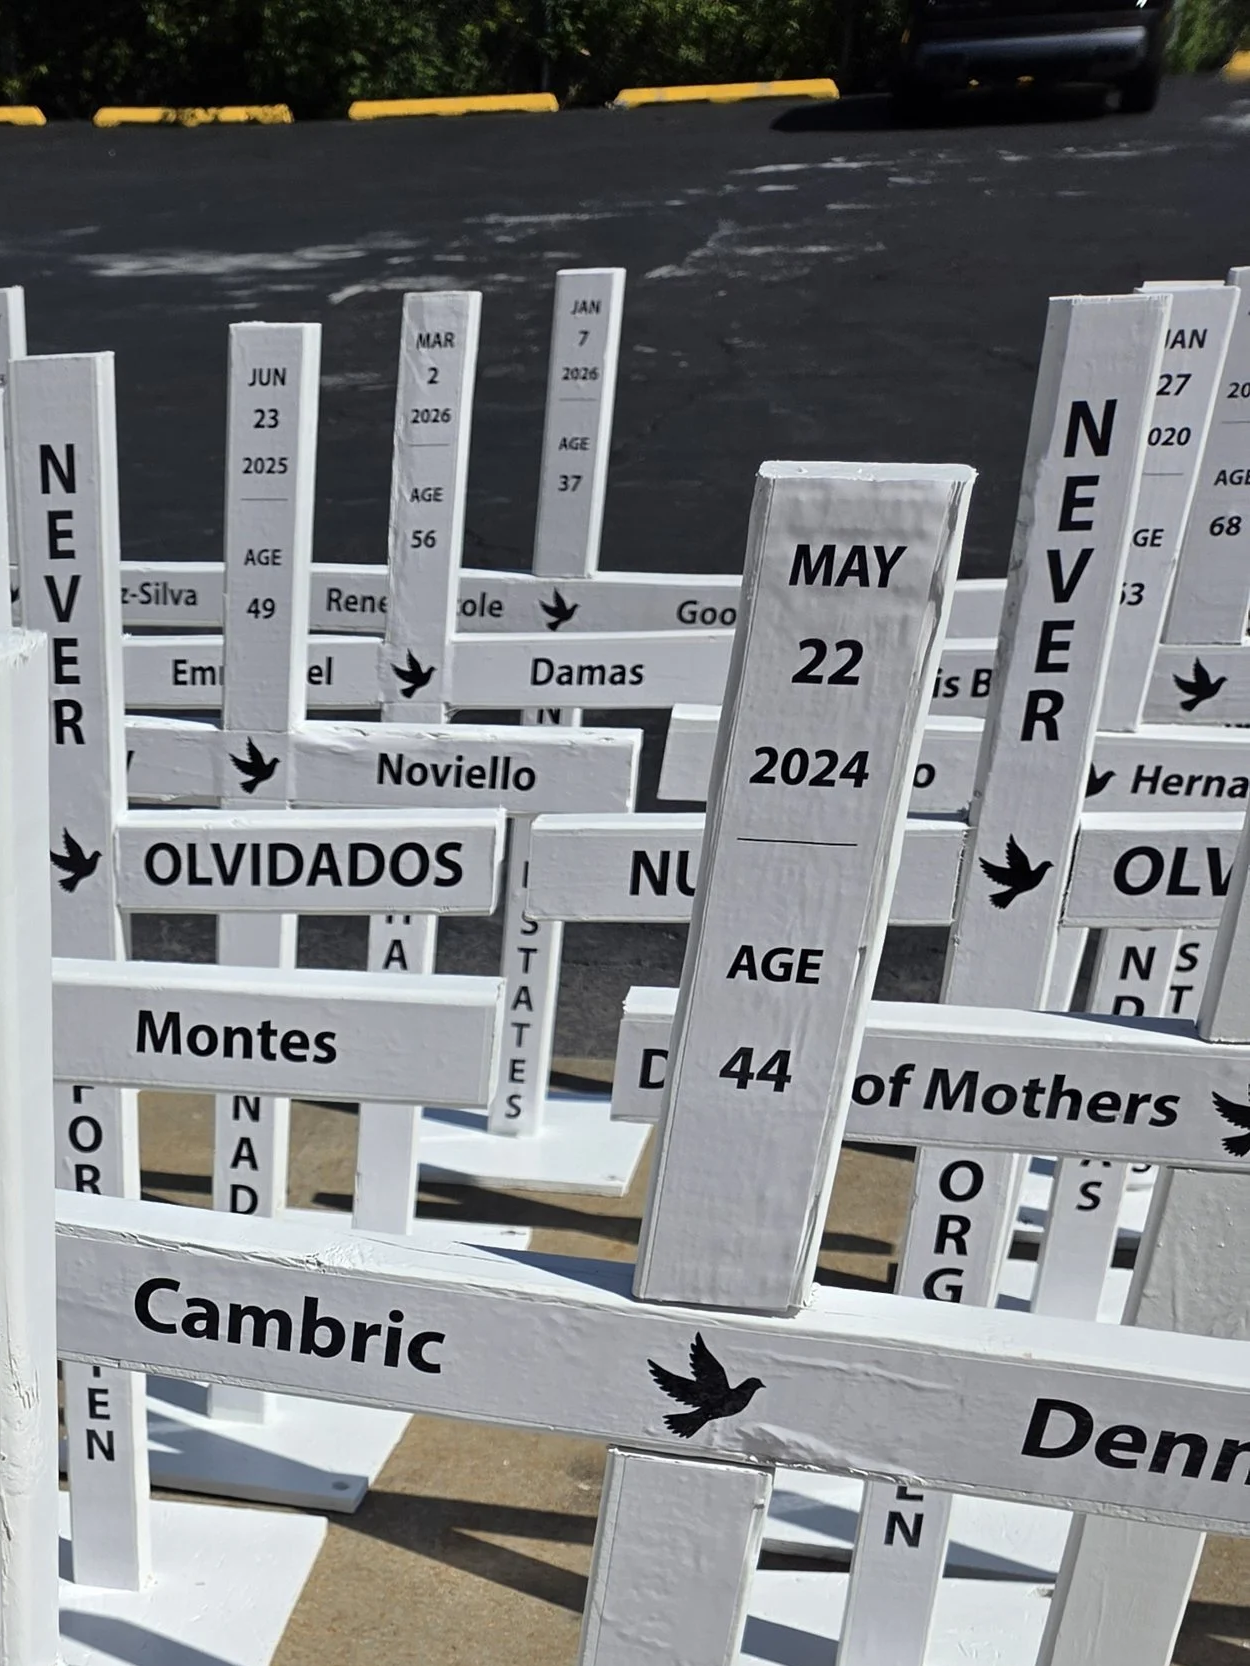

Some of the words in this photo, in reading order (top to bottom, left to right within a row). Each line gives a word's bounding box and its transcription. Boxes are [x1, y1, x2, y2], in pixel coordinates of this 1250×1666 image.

[571, 299, 601, 315] JAN
[416, 332, 455, 349] MAR
[578, 330, 588, 346] 7
[248, 367, 287, 387] JUN
[427, 367, 439, 385] 2
[562, 366, 600, 381] 2026
[1155, 373, 1191, 396] 27
[1227, 382, 1250, 398] 20
[254, 408, 279, 429] 23
[410, 407, 452, 423] 2026
[558, 435, 590, 451] AGE
[1147, 426, 1191, 447] 020
[242, 456, 288, 475] 2025
[409, 485, 444, 503] AGE
[558, 474, 582, 492] 37
[1208, 516, 1242, 537] 68
[410, 529, 437, 549] 56
[1132, 528, 1164, 548] GE
[244, 549, 282, 567] AGE
[788, 543, 908, 589] MAY
[1021, 398, 1118, 742] NEVER
[39, 442, 86, 746] NEVER
[121, 582, 198, 607] z-Silva
[246, 598, 276, 620] 49
[326, 587, 388, 614] Rene
[676, 599, 738, 626] Goo
[172, 656, 334, 686] Emel
[530, 657, 645, 687] Damas
[790, 637, 865, 687] 22
[376, 752, 537, 792] Noviello
[748, 746, 870, 789] 2024
[1130, 764, 1248, 800] Herna
[143, 841, 464, 888] OLVIDADOS
[726, 944, 824, 985] AGE
[504, 910, 540, 1119] STATES
[136, 1009, 338, 1065] Montes
[718, 1045, 792, 1094] 44
[852, 1062, 916, 1108] of
[922, 1067, 1181, 1129] Mothers
[134, 1277, 446, 1375] Cambric
